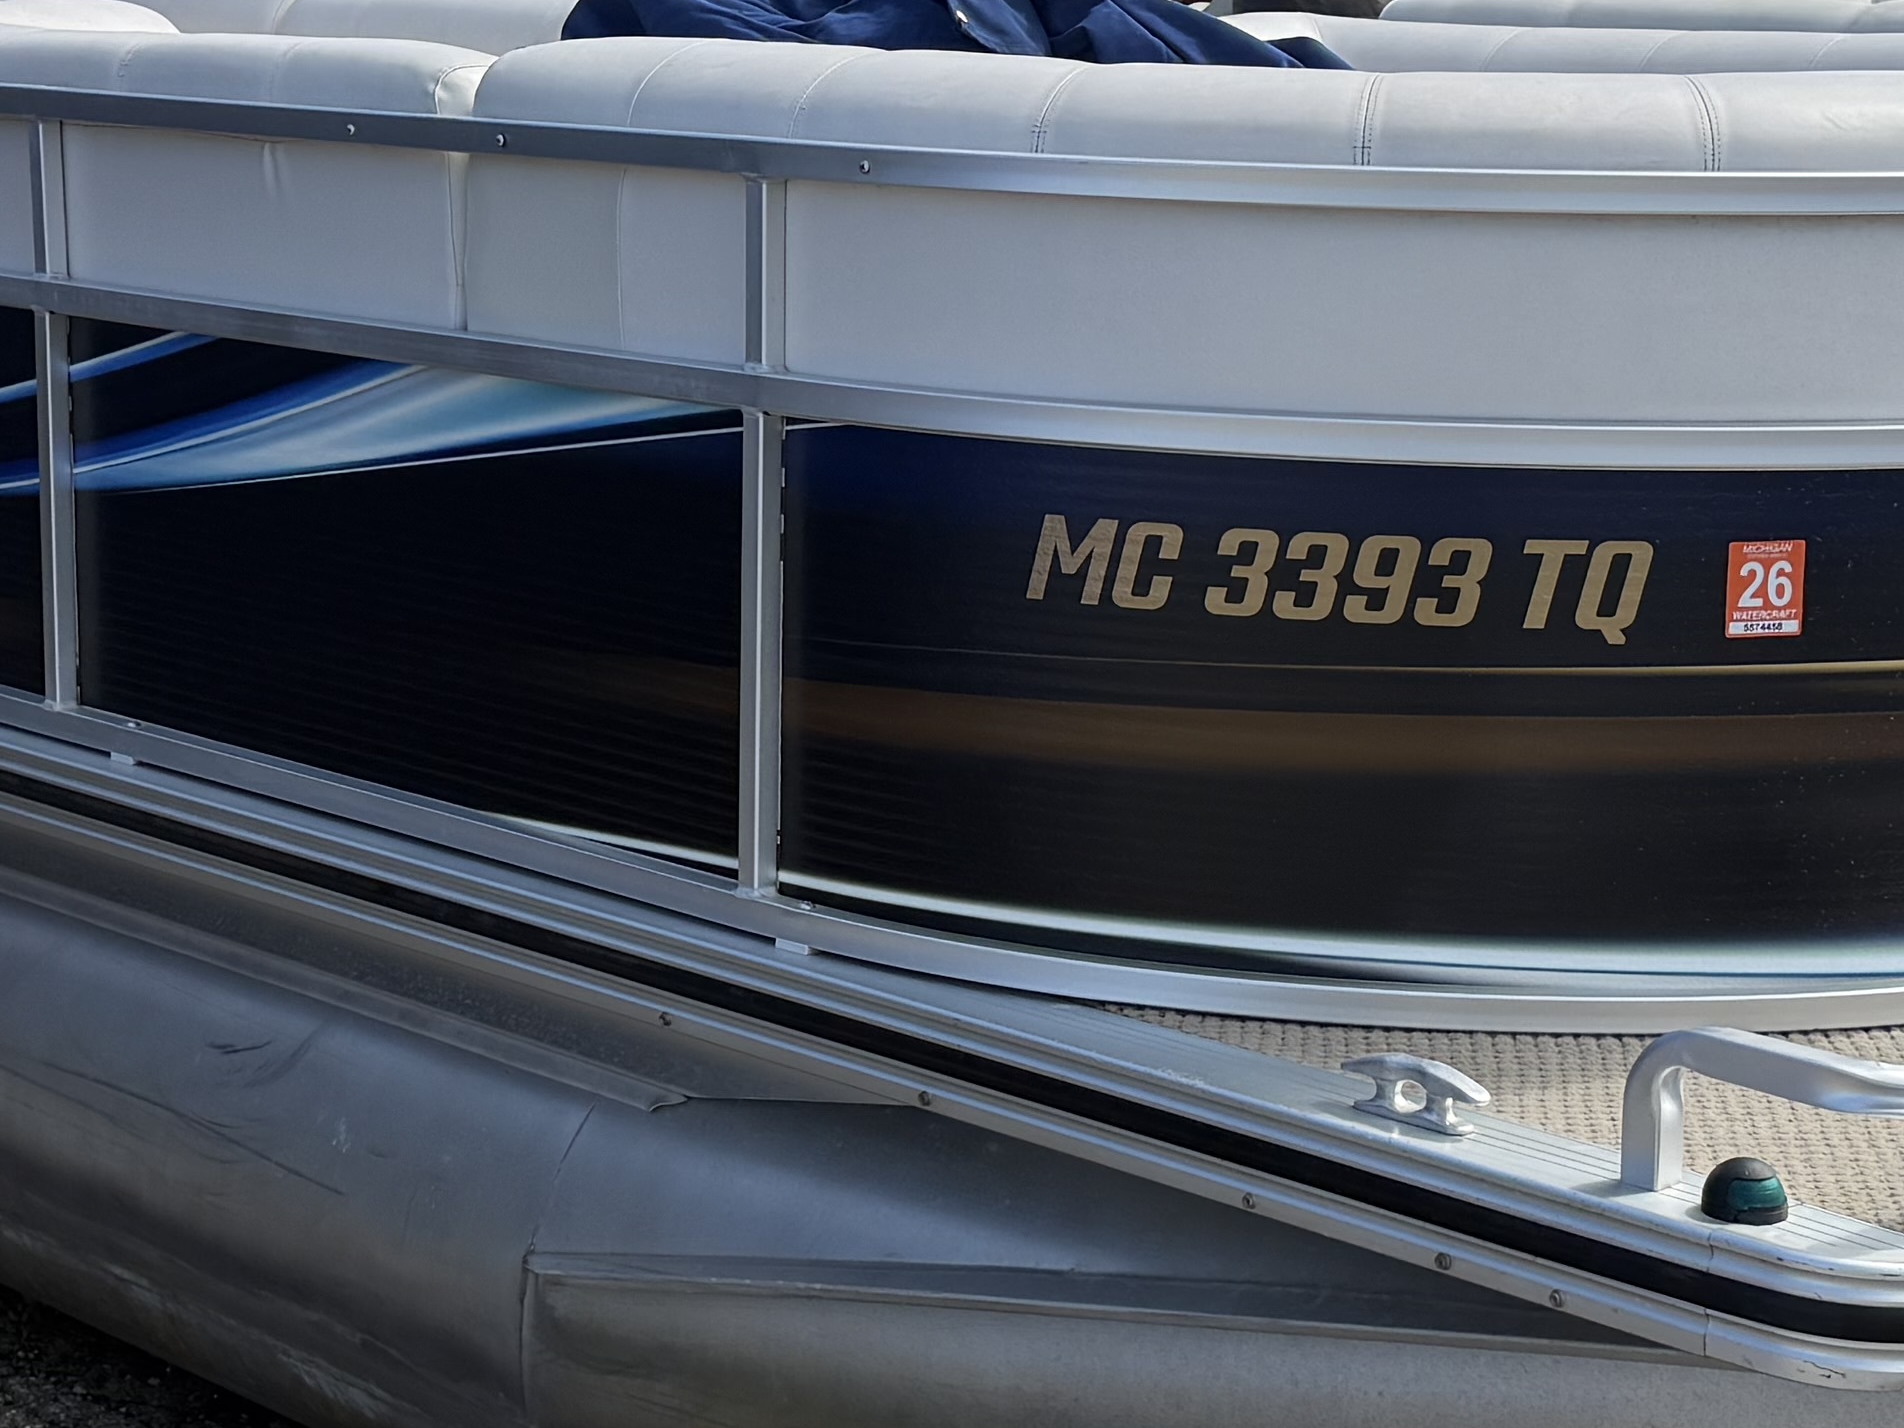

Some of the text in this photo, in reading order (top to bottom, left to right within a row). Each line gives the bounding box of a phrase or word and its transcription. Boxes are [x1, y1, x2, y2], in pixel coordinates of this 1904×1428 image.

[1026, 514, 1654, 645] MC 3393 TQ
[1737, 560, 1793, 608] 26
[1732, 609, 1797, 621] WATERCRAFT
